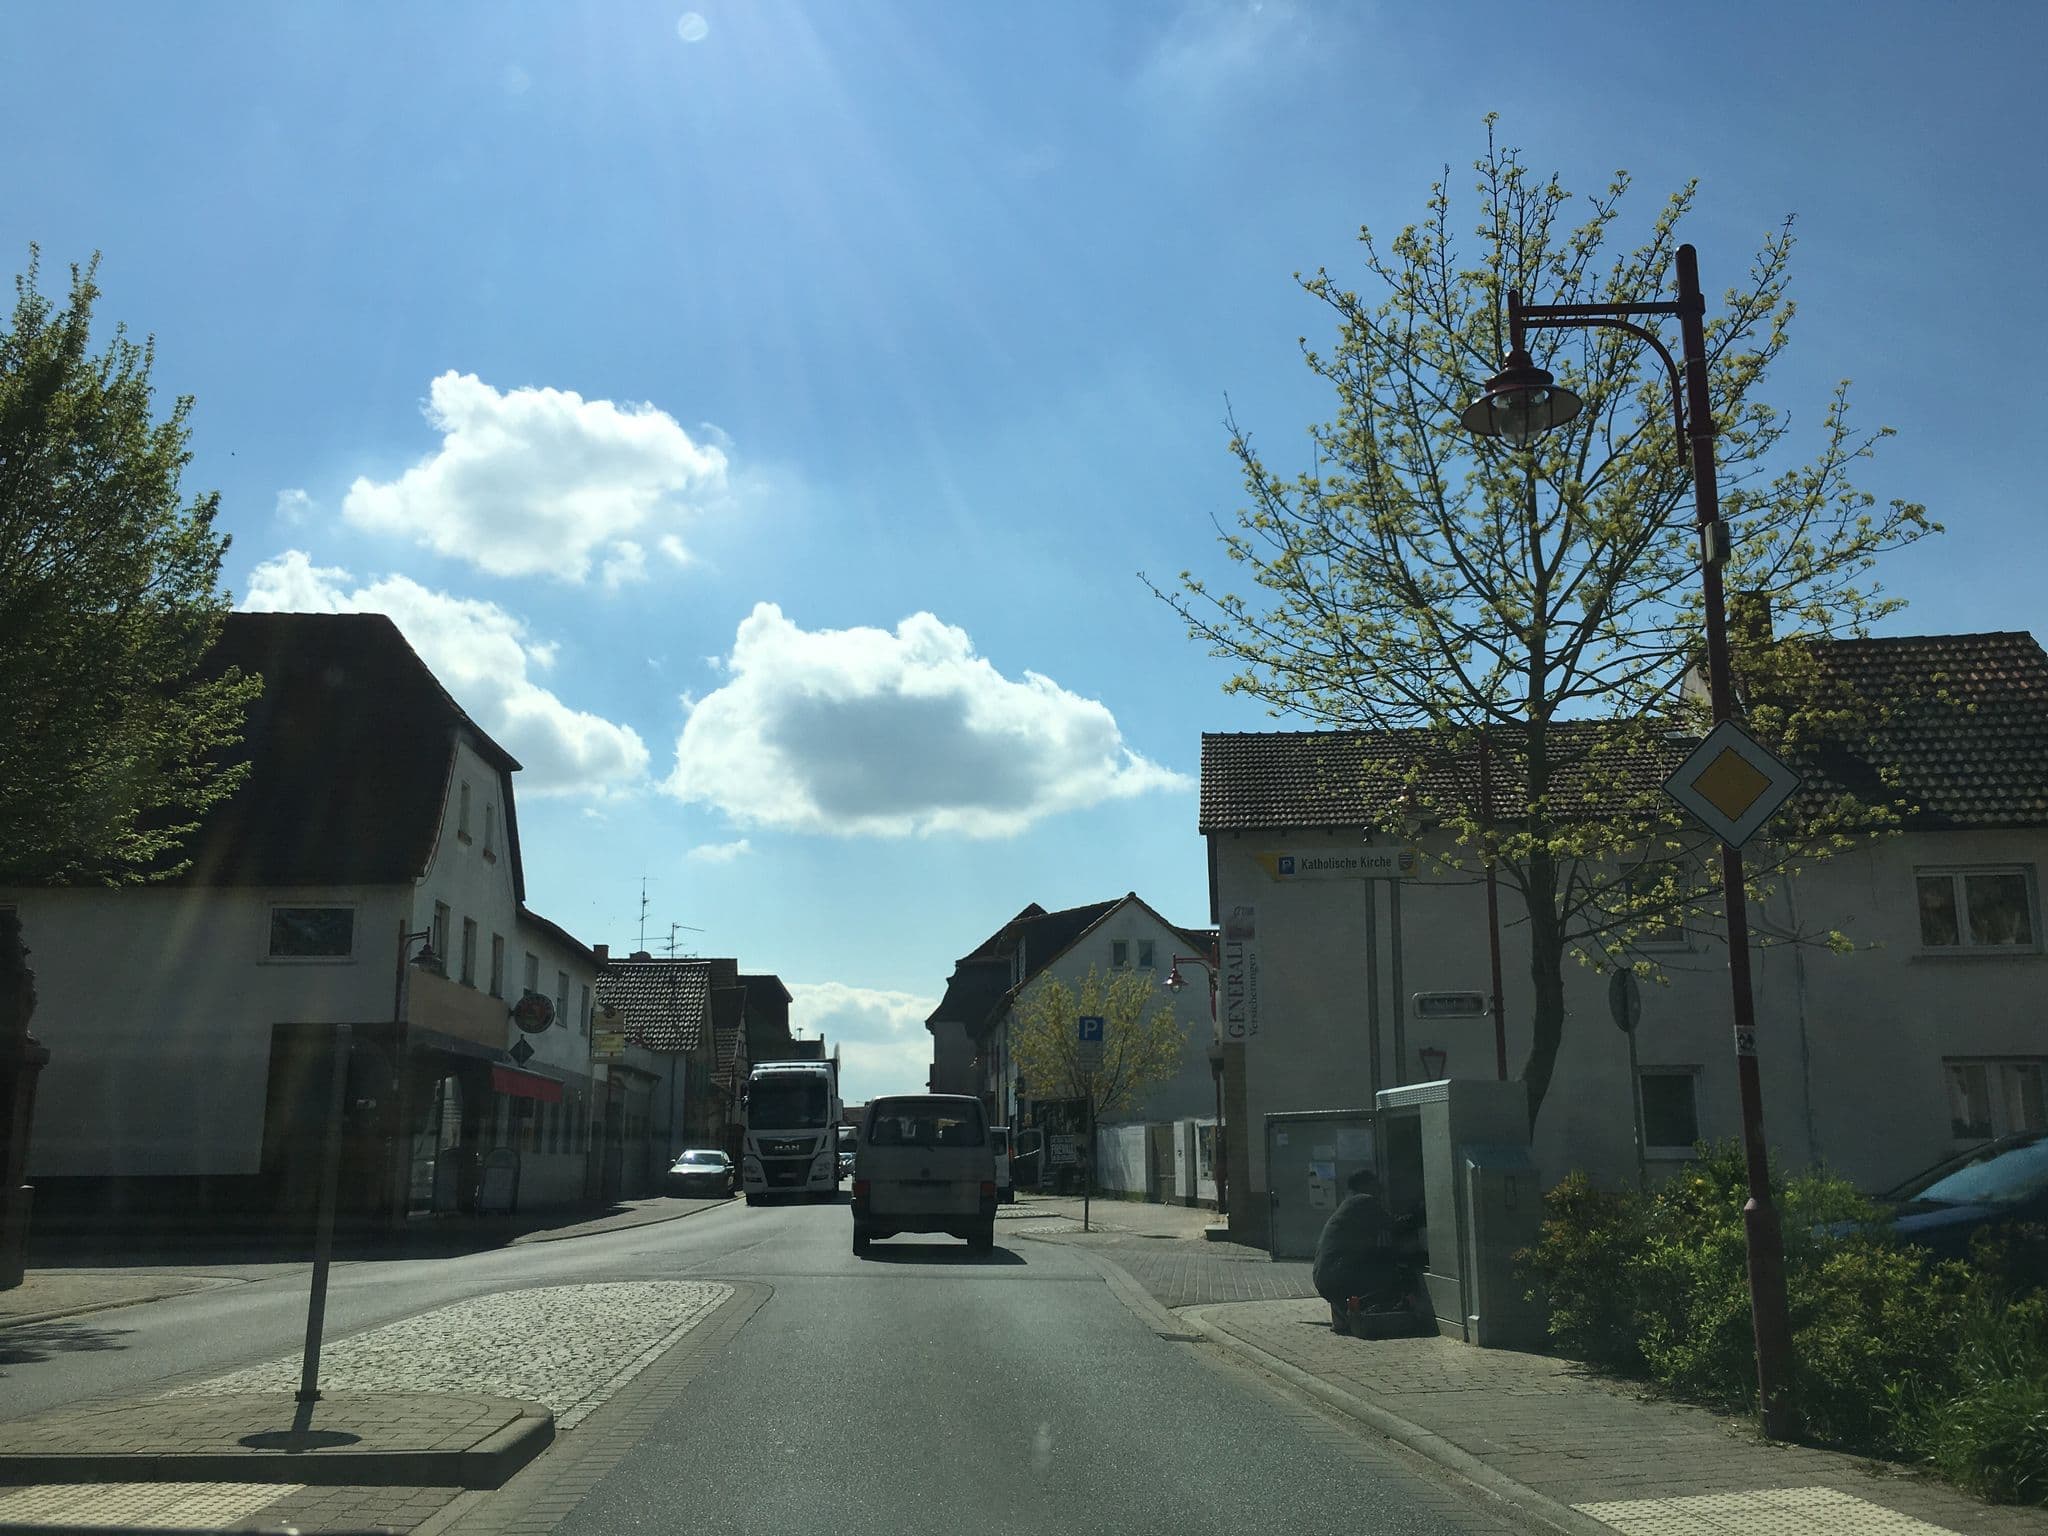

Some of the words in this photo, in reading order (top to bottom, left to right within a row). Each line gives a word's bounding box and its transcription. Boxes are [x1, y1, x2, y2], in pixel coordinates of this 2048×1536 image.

[1301, 857, 1357, 871] Katholische
[1360, 855, 1392, 868] Kirche
[1227, 941, 1245, 1039] GENERALI
[1248, 953, 1258, 1036] Versicherungen
[1084, 1020, 1098, 1039] P
